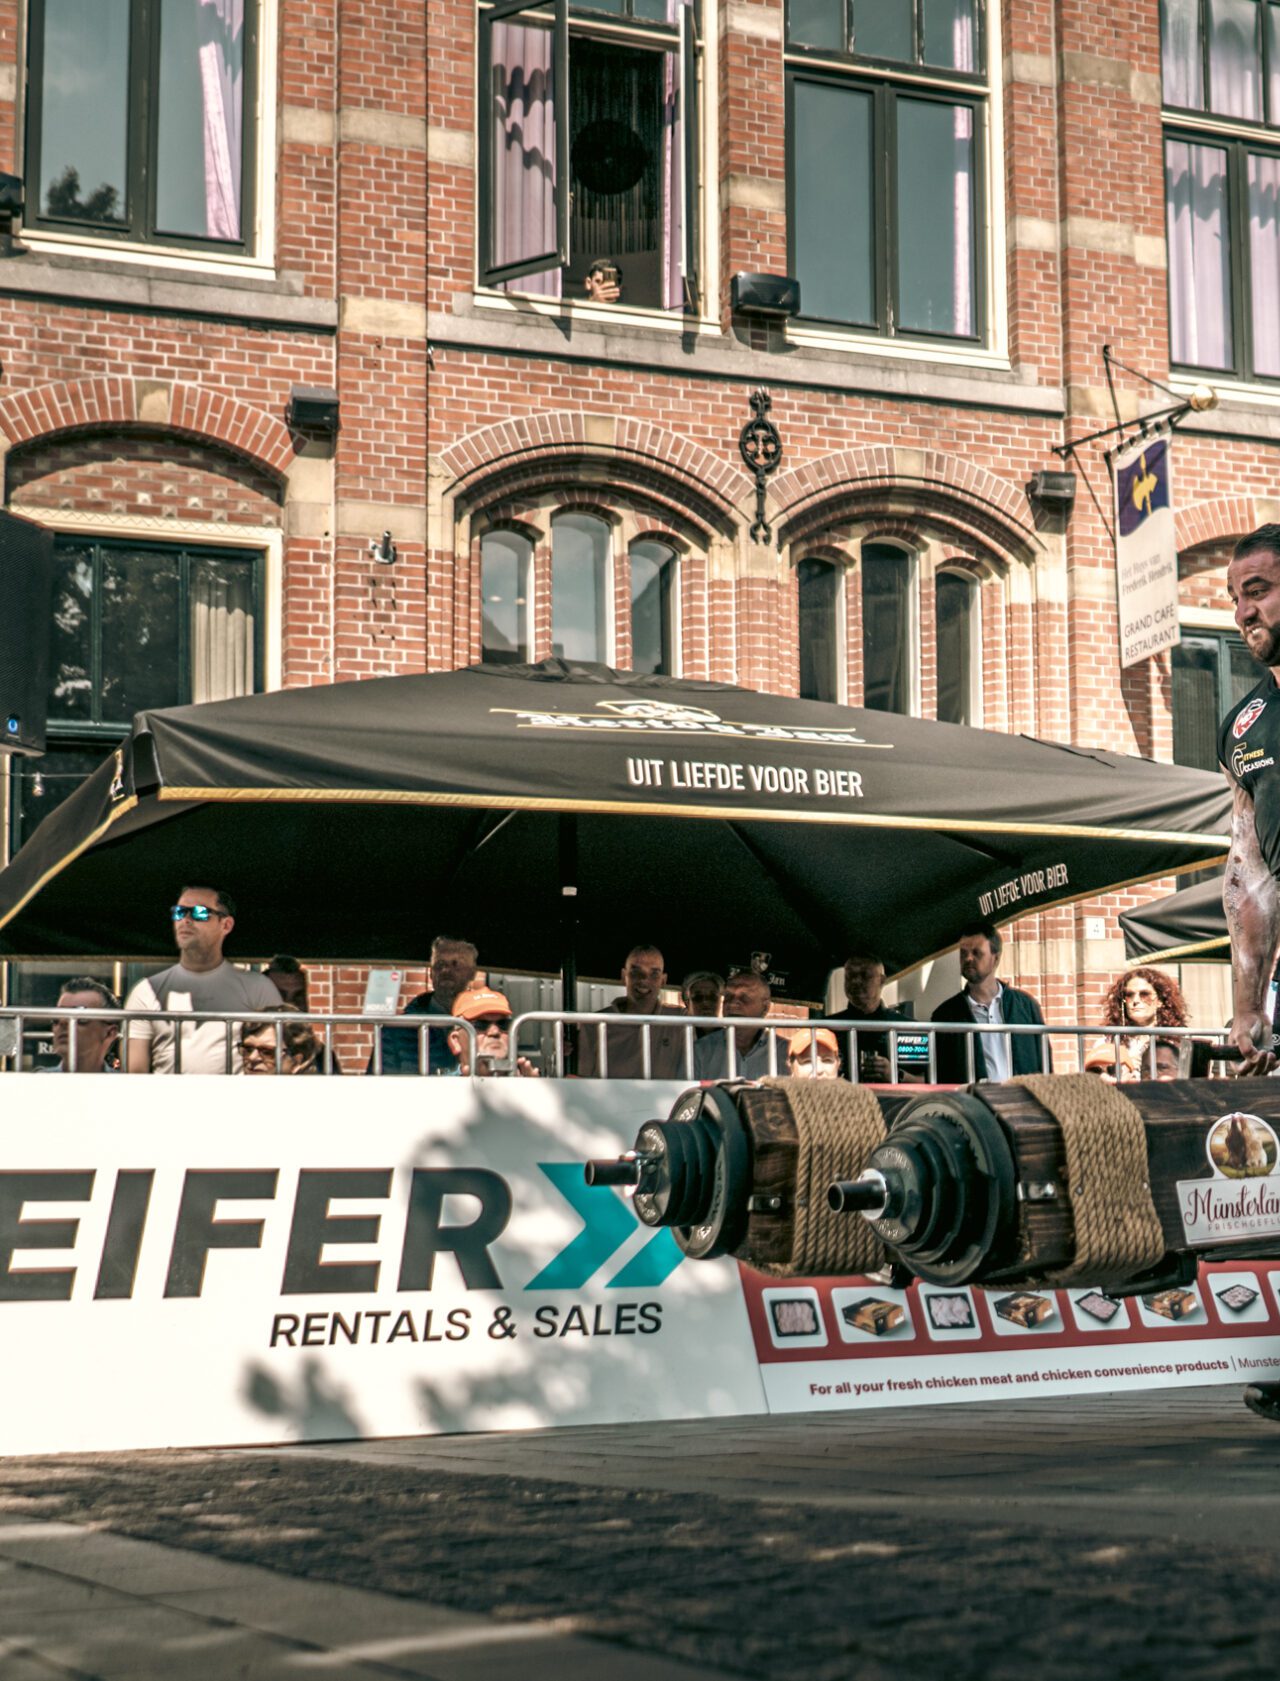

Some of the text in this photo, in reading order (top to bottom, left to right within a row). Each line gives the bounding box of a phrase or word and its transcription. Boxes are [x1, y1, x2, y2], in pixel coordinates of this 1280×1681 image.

[1124, 602, 1176, 638] GRAND CAFÉ
[1125, 625, 1177, 660] RESTAURANT
[626, 757, 864, 798] UIT LIEFDE VOOR BIER
[978, 862, 1070, 917] UIT LIEFDE VOOR BIER
[767, 972, 786, 985] Jan
[897, 1036, 922, 1045] PFEIFER
[0, 1167, 514, 1302] EIFER
[269, 1301, 664, 1348] RENTALS & SALES
[809, 1382, 832, 1396] For
[835, 1381, 852, 1394] all
[854, 1381, 885, 1397] your
[887, 1377, 923, 1391] fresh
[925, 1374, 978, 1389] chicken
[980, 1373, 1013, 1386] meat
[1015, 1370, 1040, 1383] and
[1042, 1366, 1092, 1382] chicken
[1094, 1363, 1174, 1379] convenience
[1175, 1360, 1230, 1376] products
